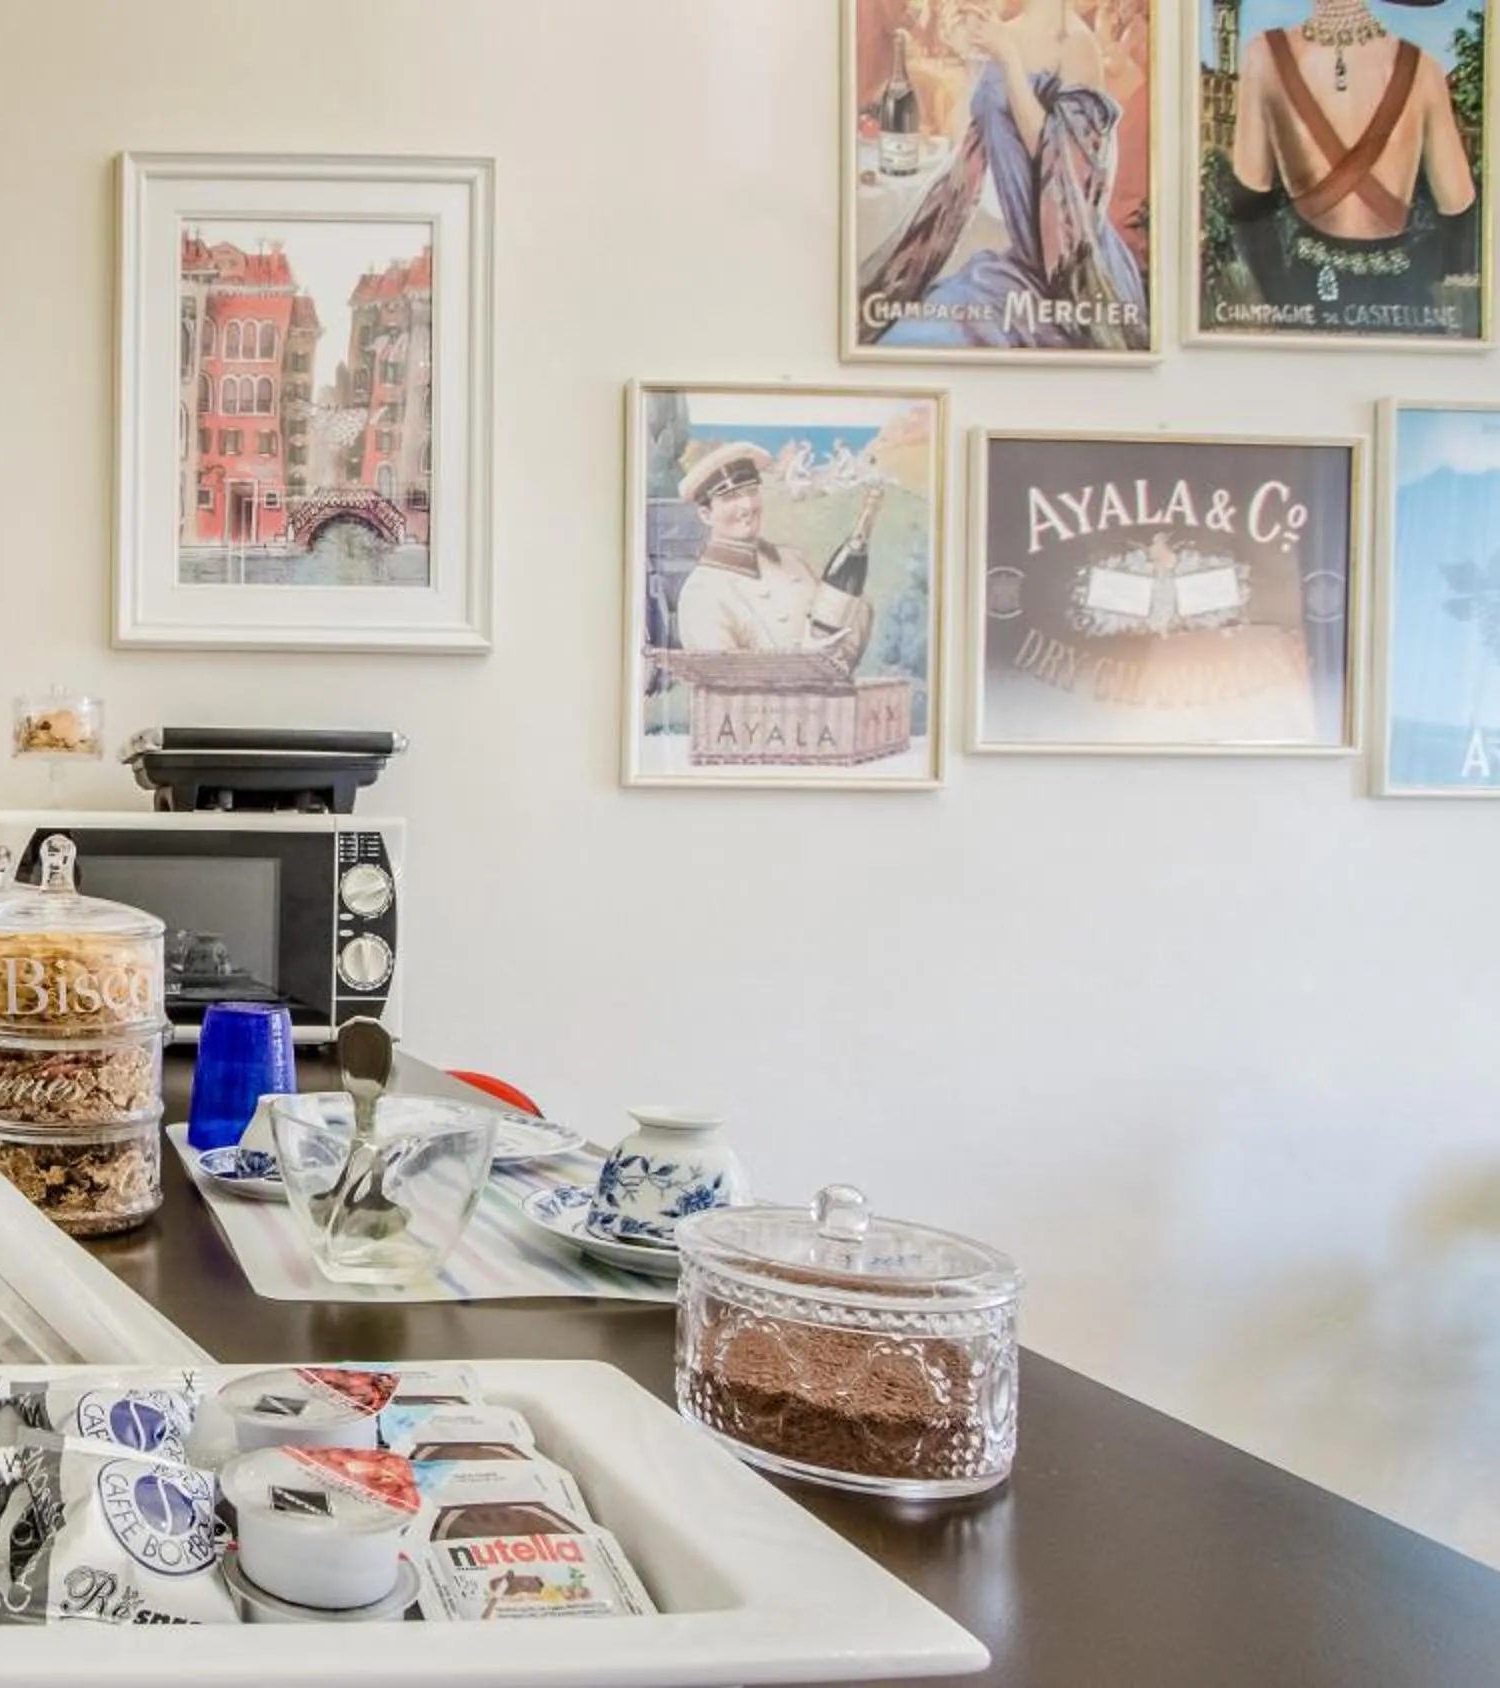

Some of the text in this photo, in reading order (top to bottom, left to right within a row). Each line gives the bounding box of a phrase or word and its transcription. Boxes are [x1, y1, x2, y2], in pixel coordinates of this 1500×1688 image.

[862, 292, 994, 328] CHAMPAGNE
[1214, 300, 1317, 326] CHAMPAGNE
[1342, 303, 1461, 329] CASTELLANE
[1027, 478, 1200, 555] AYALA
[1205, 488, 1237, 534] &
[1012, 628, 1092, 693] DRY
[716, 711, 838, 748] AYALA
[448, 1533, 585, 1567] nutella
